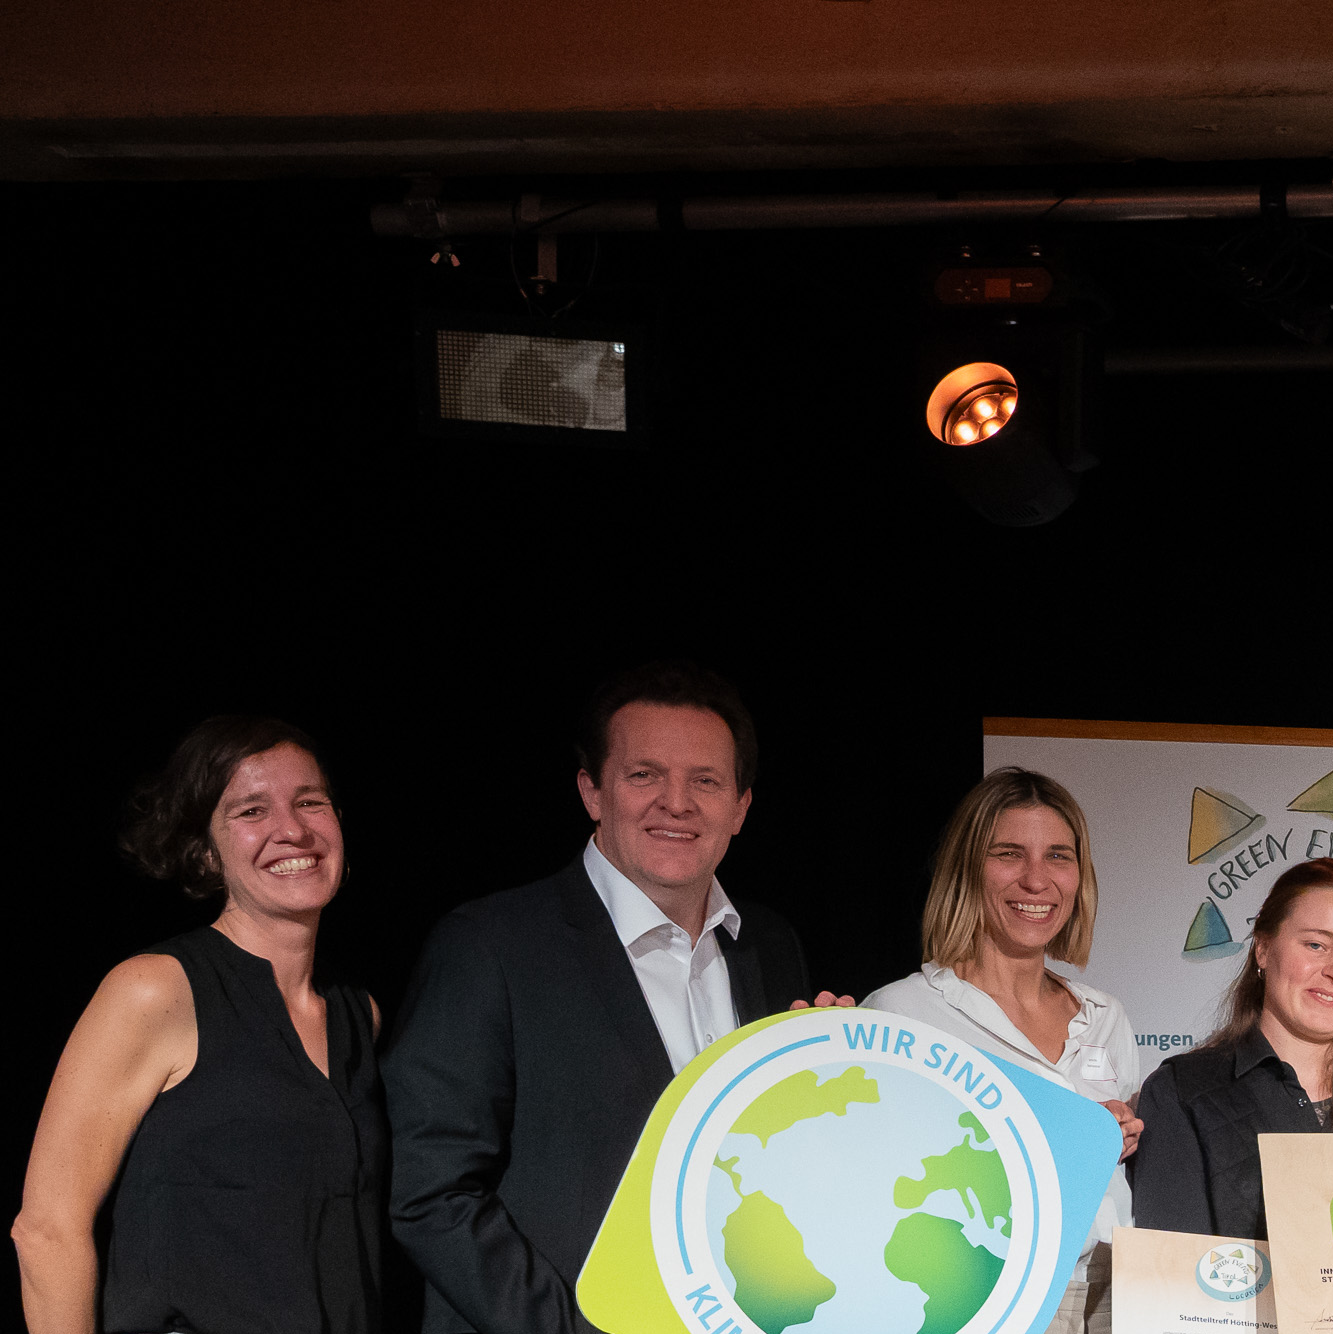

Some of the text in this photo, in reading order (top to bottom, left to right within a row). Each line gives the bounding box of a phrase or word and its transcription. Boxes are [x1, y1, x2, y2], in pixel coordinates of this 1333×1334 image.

[1207, 828, 1293, 900] GREEN
[842, 1022, 1003, 1111] WIR SIND
[1180, 1315, 1278, 1331] Stadtteiltreff Hötting-Wes
